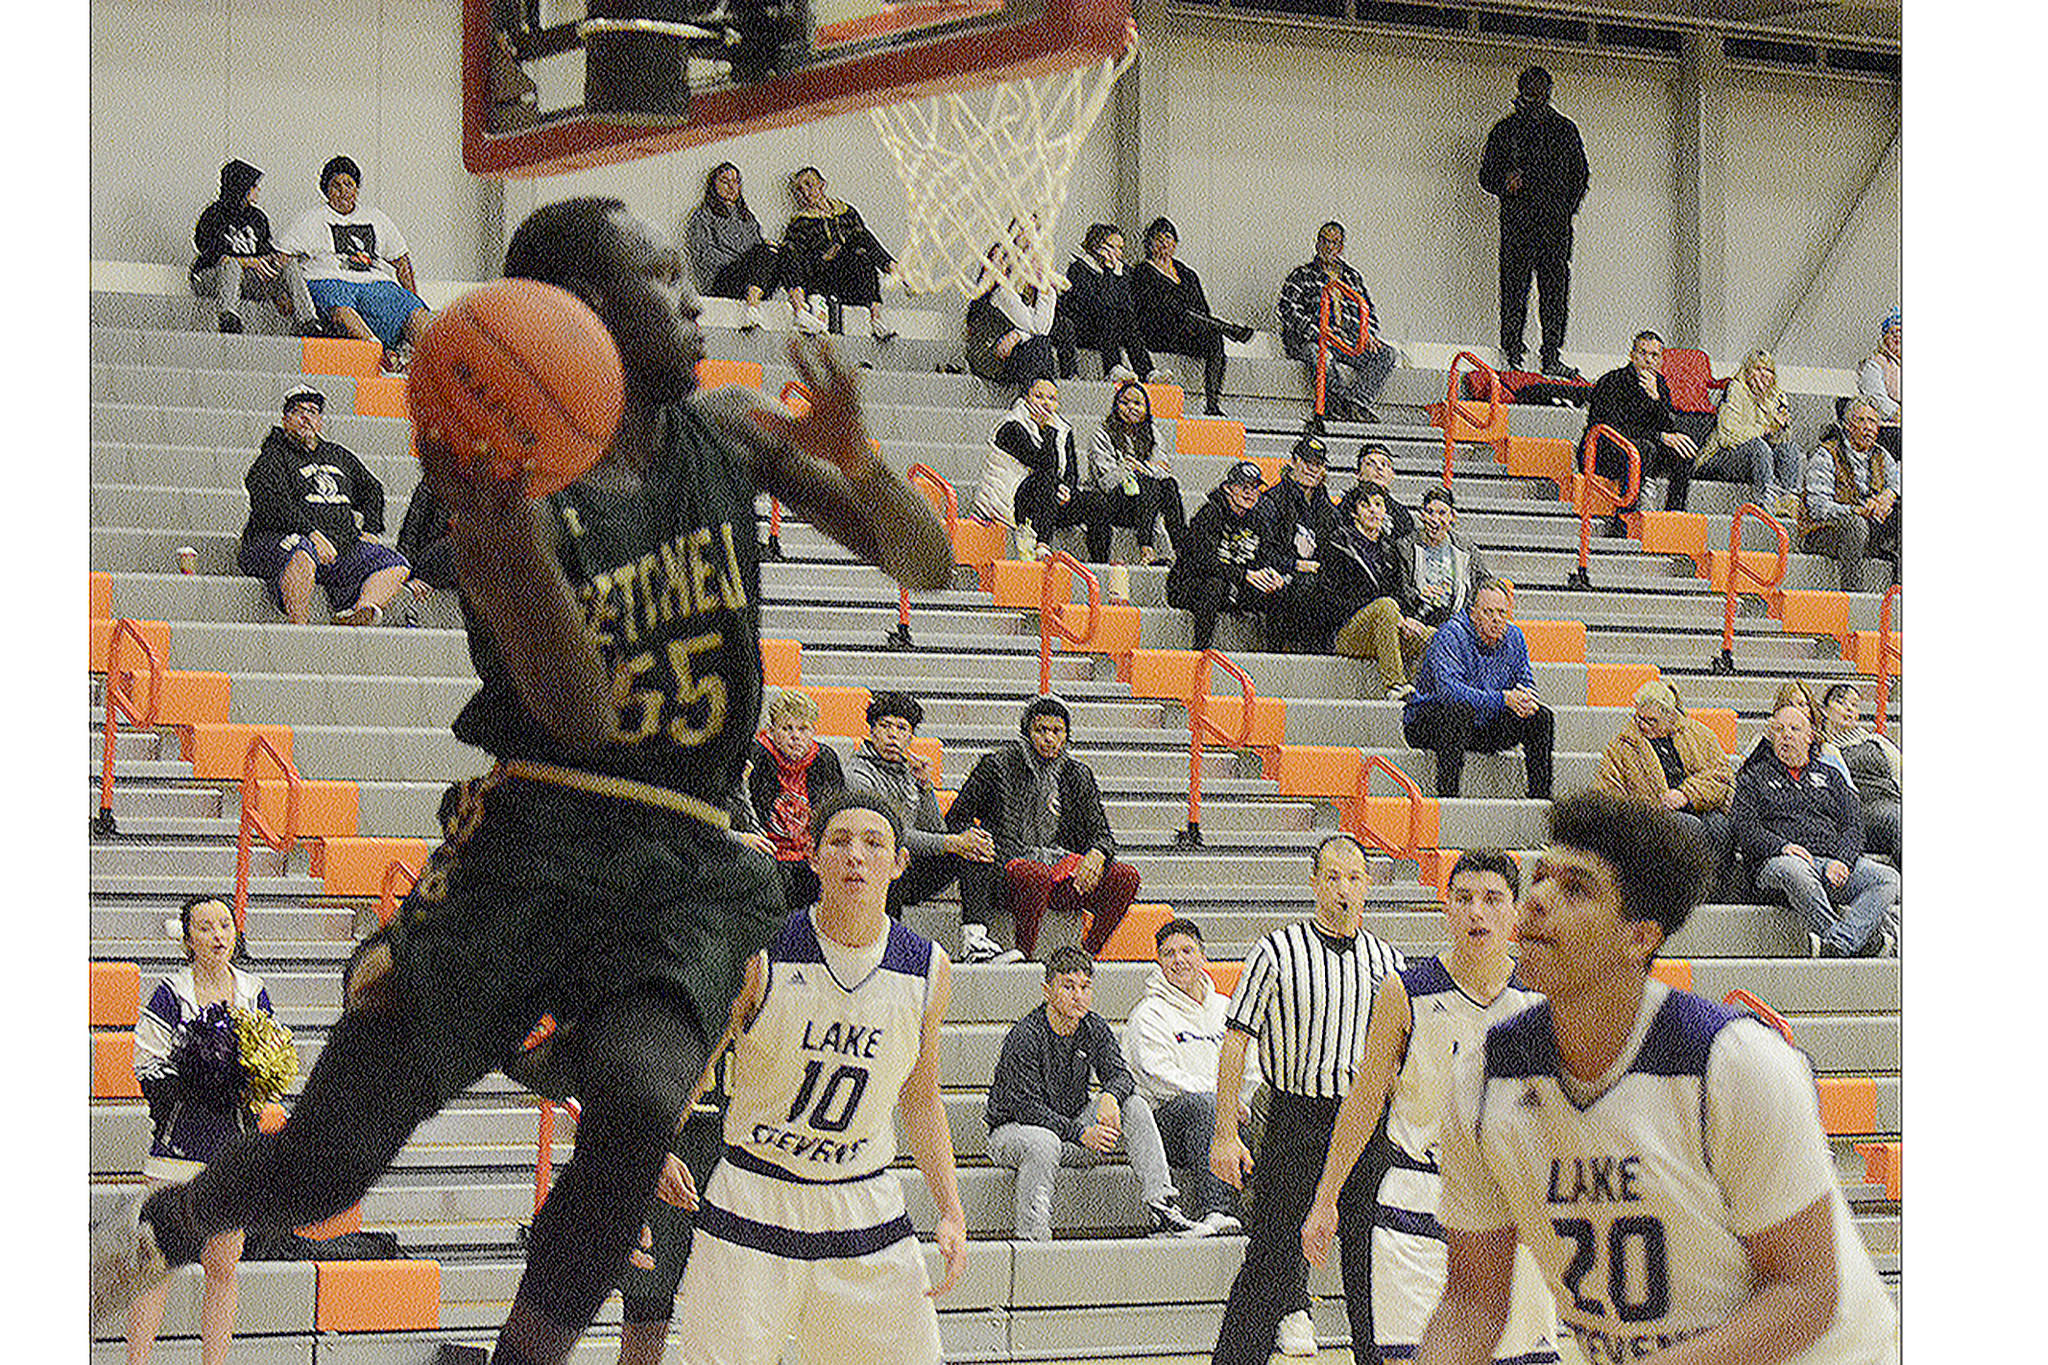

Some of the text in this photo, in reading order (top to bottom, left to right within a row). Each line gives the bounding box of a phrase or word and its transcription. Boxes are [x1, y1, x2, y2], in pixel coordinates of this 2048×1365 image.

[802, 1020, 882, 1059] LAKE
[787, 1060, 869, 1132] 10
[1547, 1156, 1643, 1204] LAKE
[1551, 1215, 1670, 1322] 20
